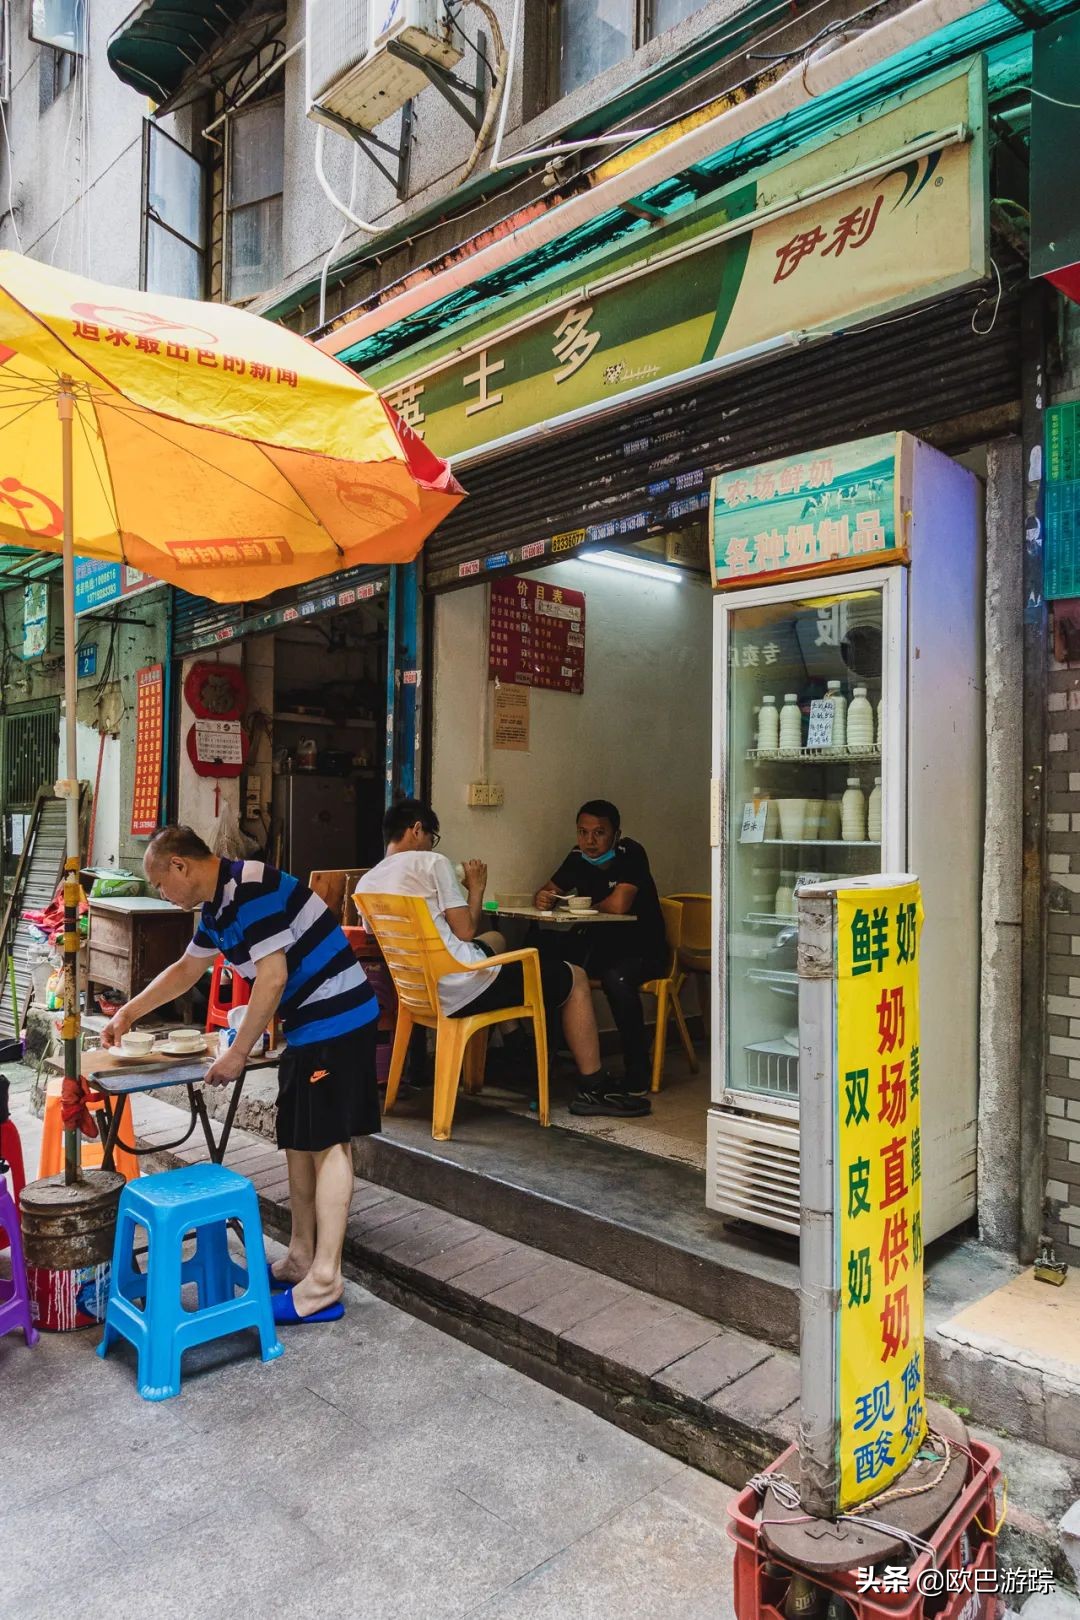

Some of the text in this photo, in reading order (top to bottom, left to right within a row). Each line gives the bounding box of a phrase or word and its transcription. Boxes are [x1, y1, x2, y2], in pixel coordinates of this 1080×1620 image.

[773, 194, 884, 285] 伊利
[72, 319, 298, 388] 追求最出色的新闻
[724, 458, 834, 509] 农场鲜奶
[724, 509, 886, 575] 各种奶制品
[517, 581, 563, 604] 价目表
[850, 903, 917, 976] 鲜奶
[845, 1068, 872, 1308] 双皮奶
[876, 986, 909, 1363] 奶场直供奶
[853, 1351, 921, 1431] 现做
[853, 1405, 923, 1484] 酸奶
